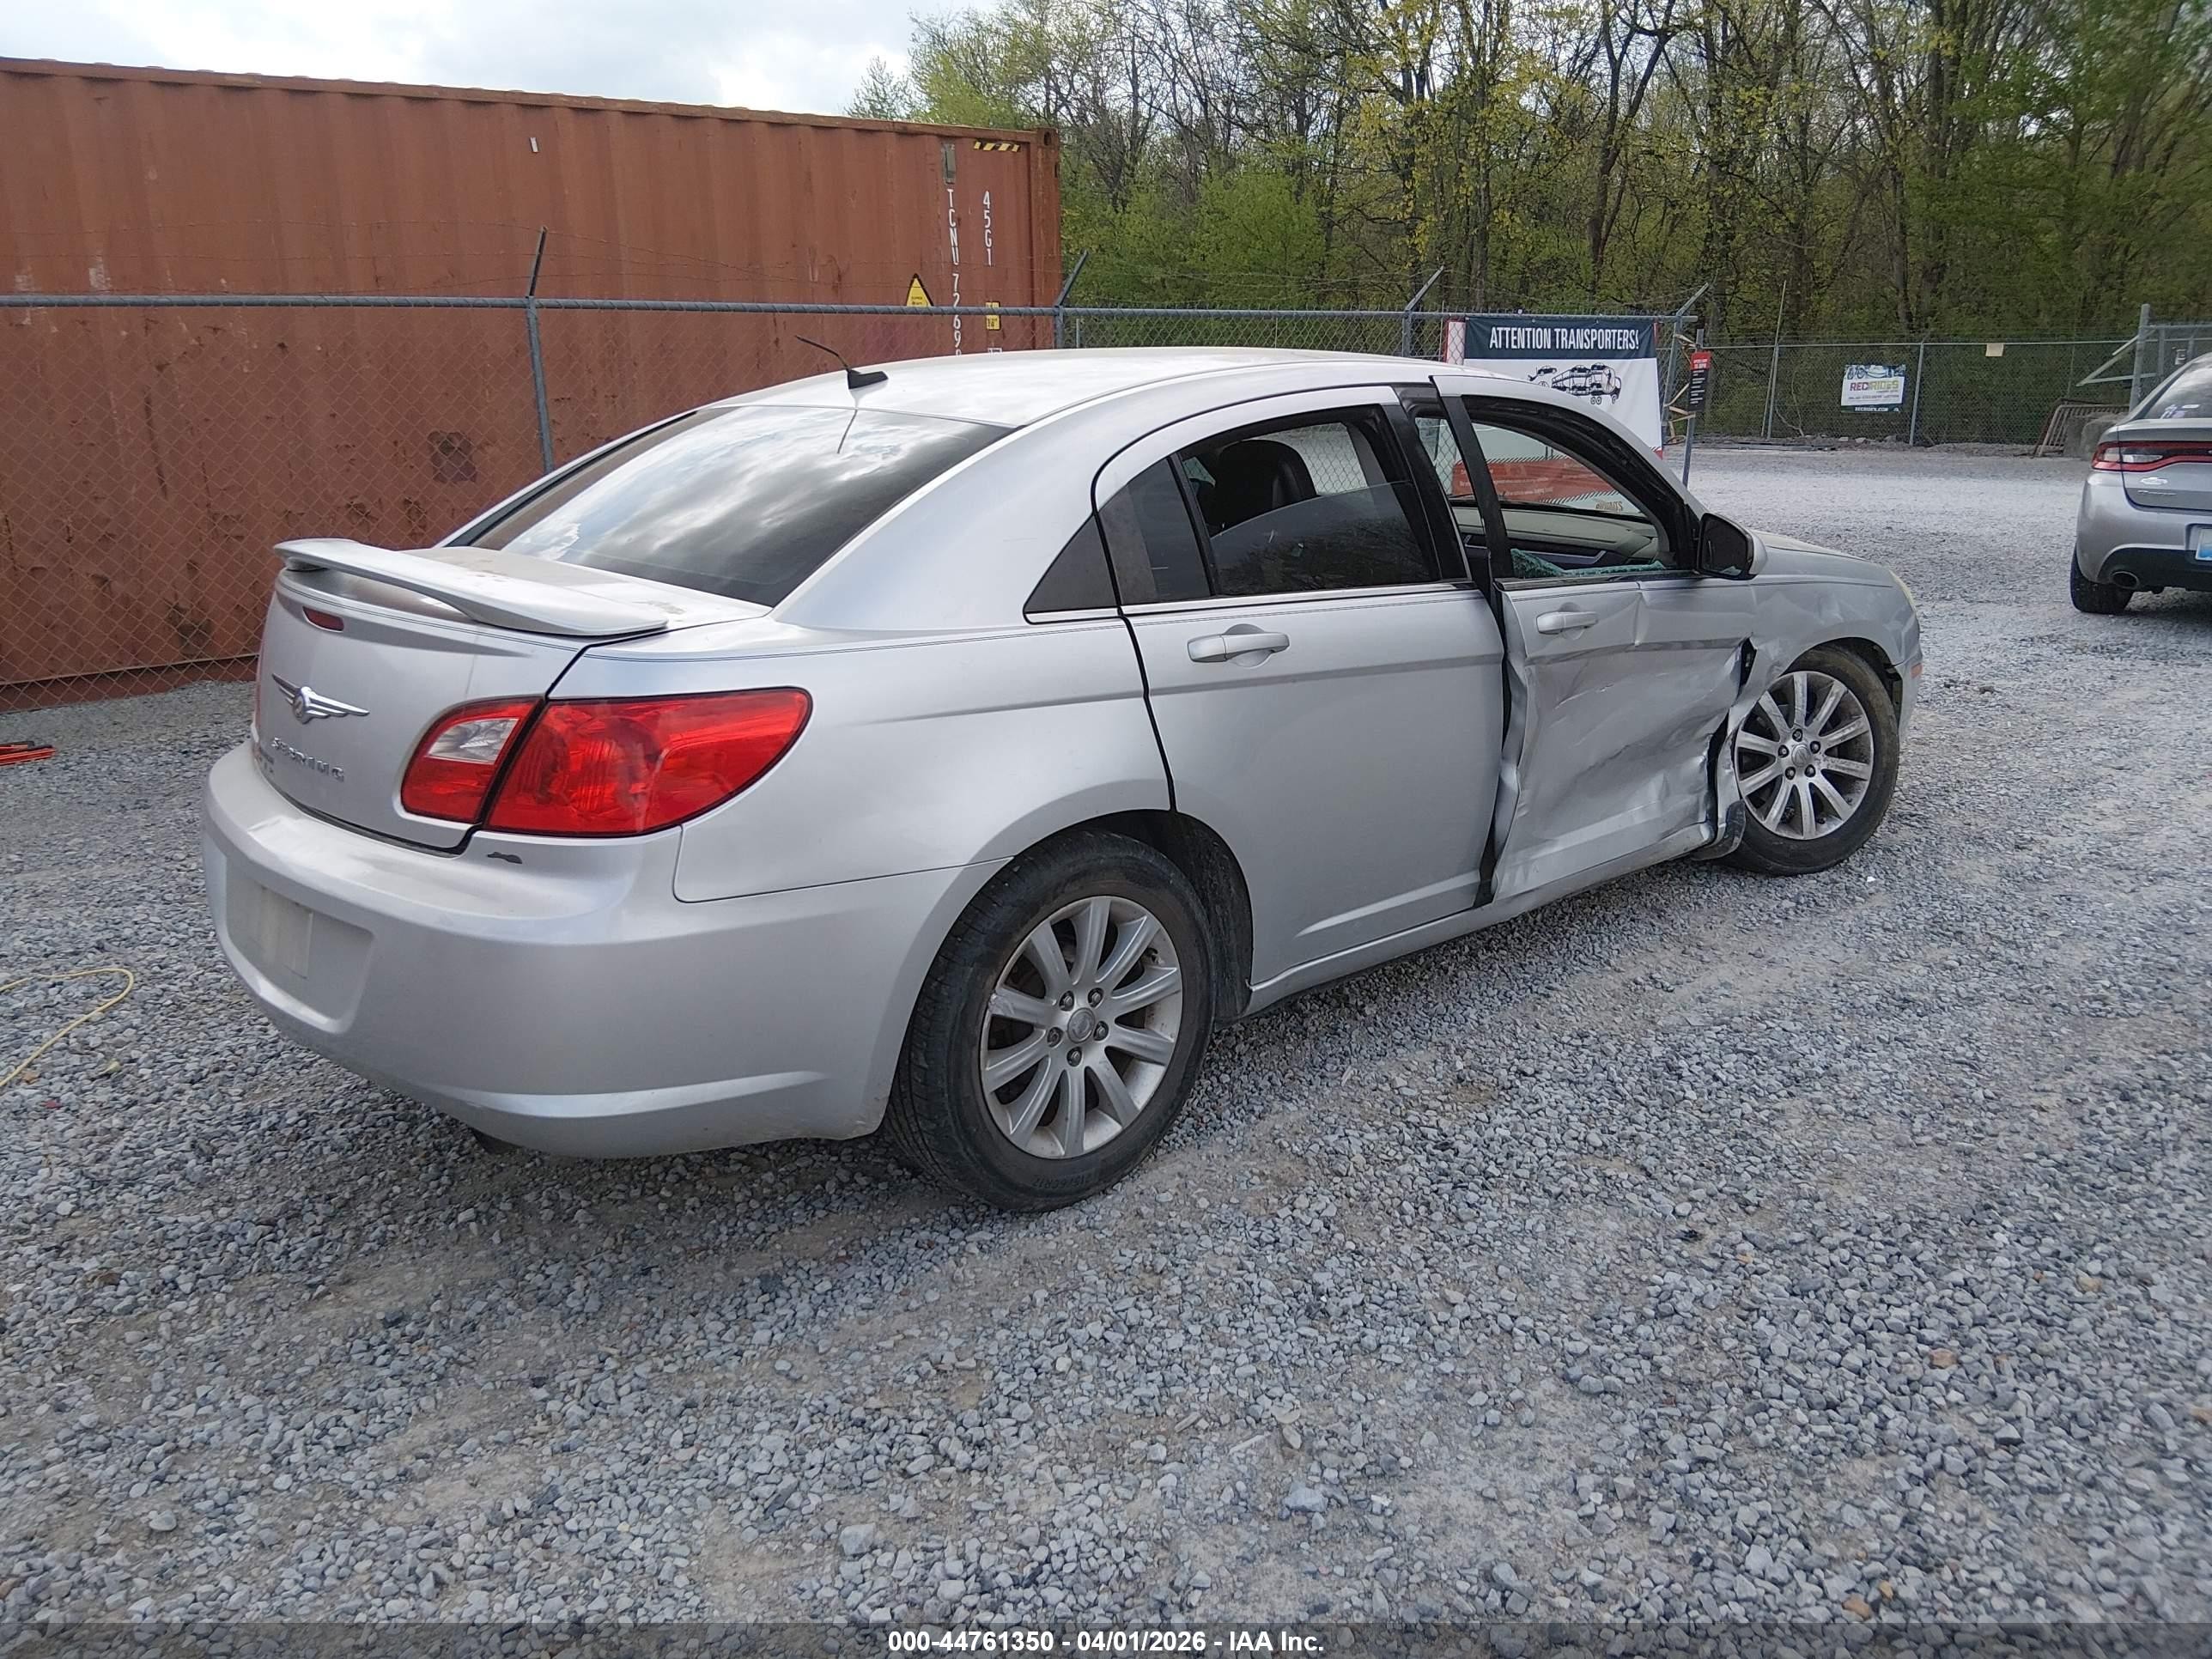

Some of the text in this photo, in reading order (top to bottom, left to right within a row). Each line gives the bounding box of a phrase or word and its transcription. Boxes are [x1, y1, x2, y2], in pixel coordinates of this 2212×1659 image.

[947, 188, 959, 266] TCNU
[982, 190, 993, 267] 45G1
[1489, 326, 1639, 350] ATTENTION TRANSPORTERS!
